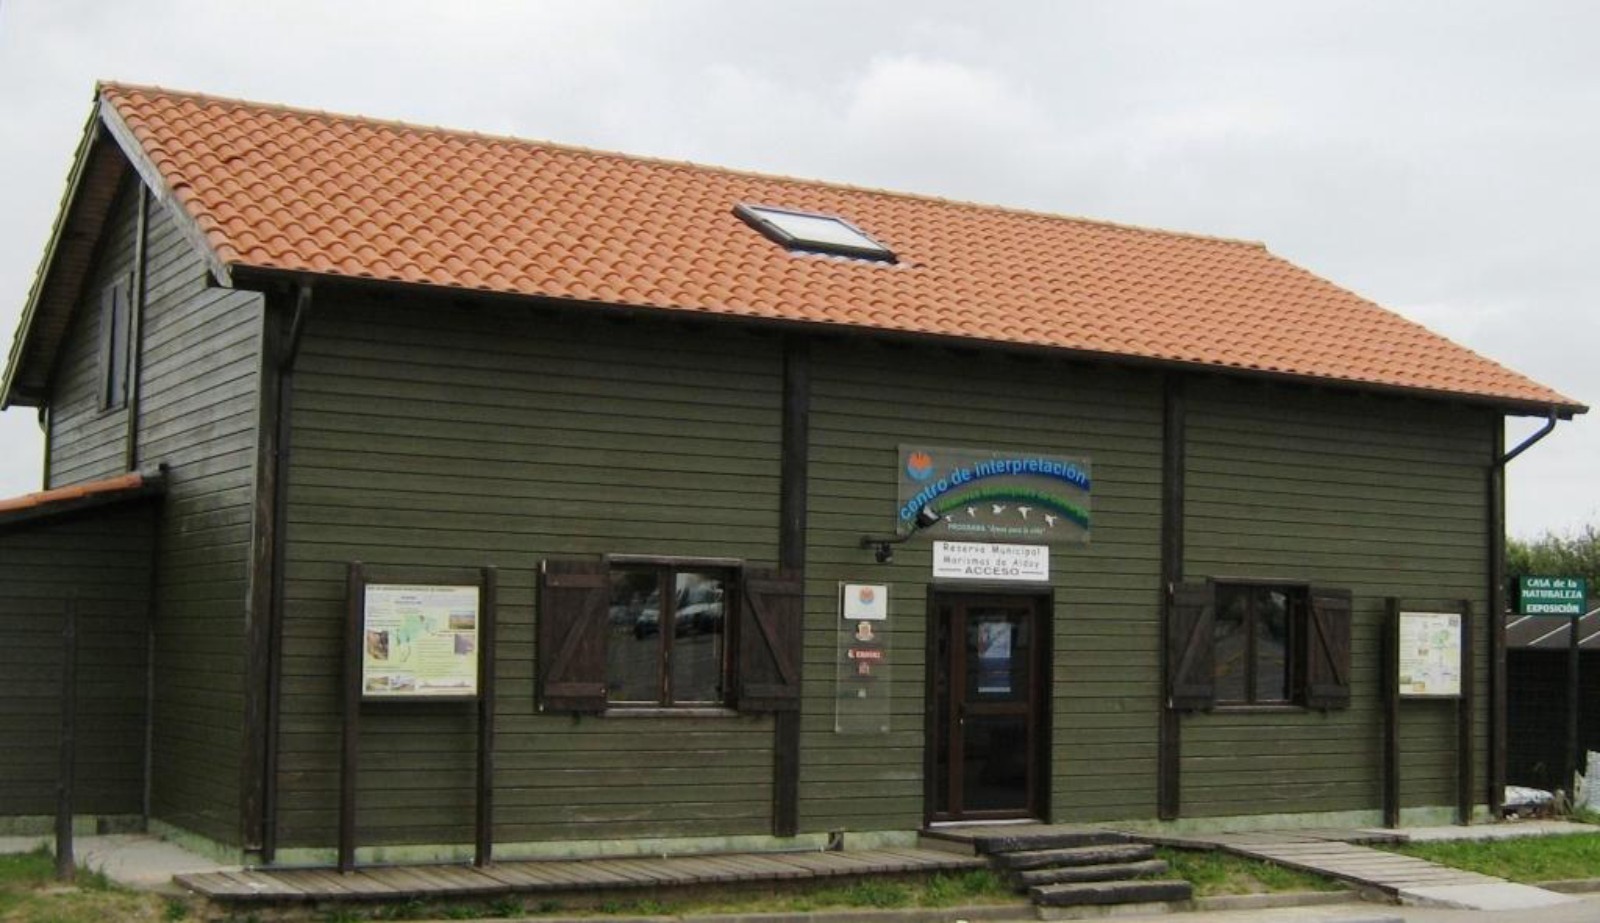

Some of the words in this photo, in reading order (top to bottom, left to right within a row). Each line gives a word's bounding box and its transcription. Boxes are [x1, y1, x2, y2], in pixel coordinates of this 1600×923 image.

[901, 479, 947, 519] centro
[951, 467, 970, 484] de
[975, 458, 1086, 484] interpretación
[943, 543, 985, 554] Reserva
[992, 545, 1040, 557] Municipal
[943, 556, 990, 566] Marismas
[995, 559, 1007, 567] de
[964, 566, 1020, 576] ACCESO
[1527, 579, 1551, 588] CASA
[1553, 579, 1566, 588] de
[1568, 579, 1578, 588] la
[1522, 589, 1582, 599] NATURALEZA
[1526, 603, 1579, 613] EXPOSICIÓN
